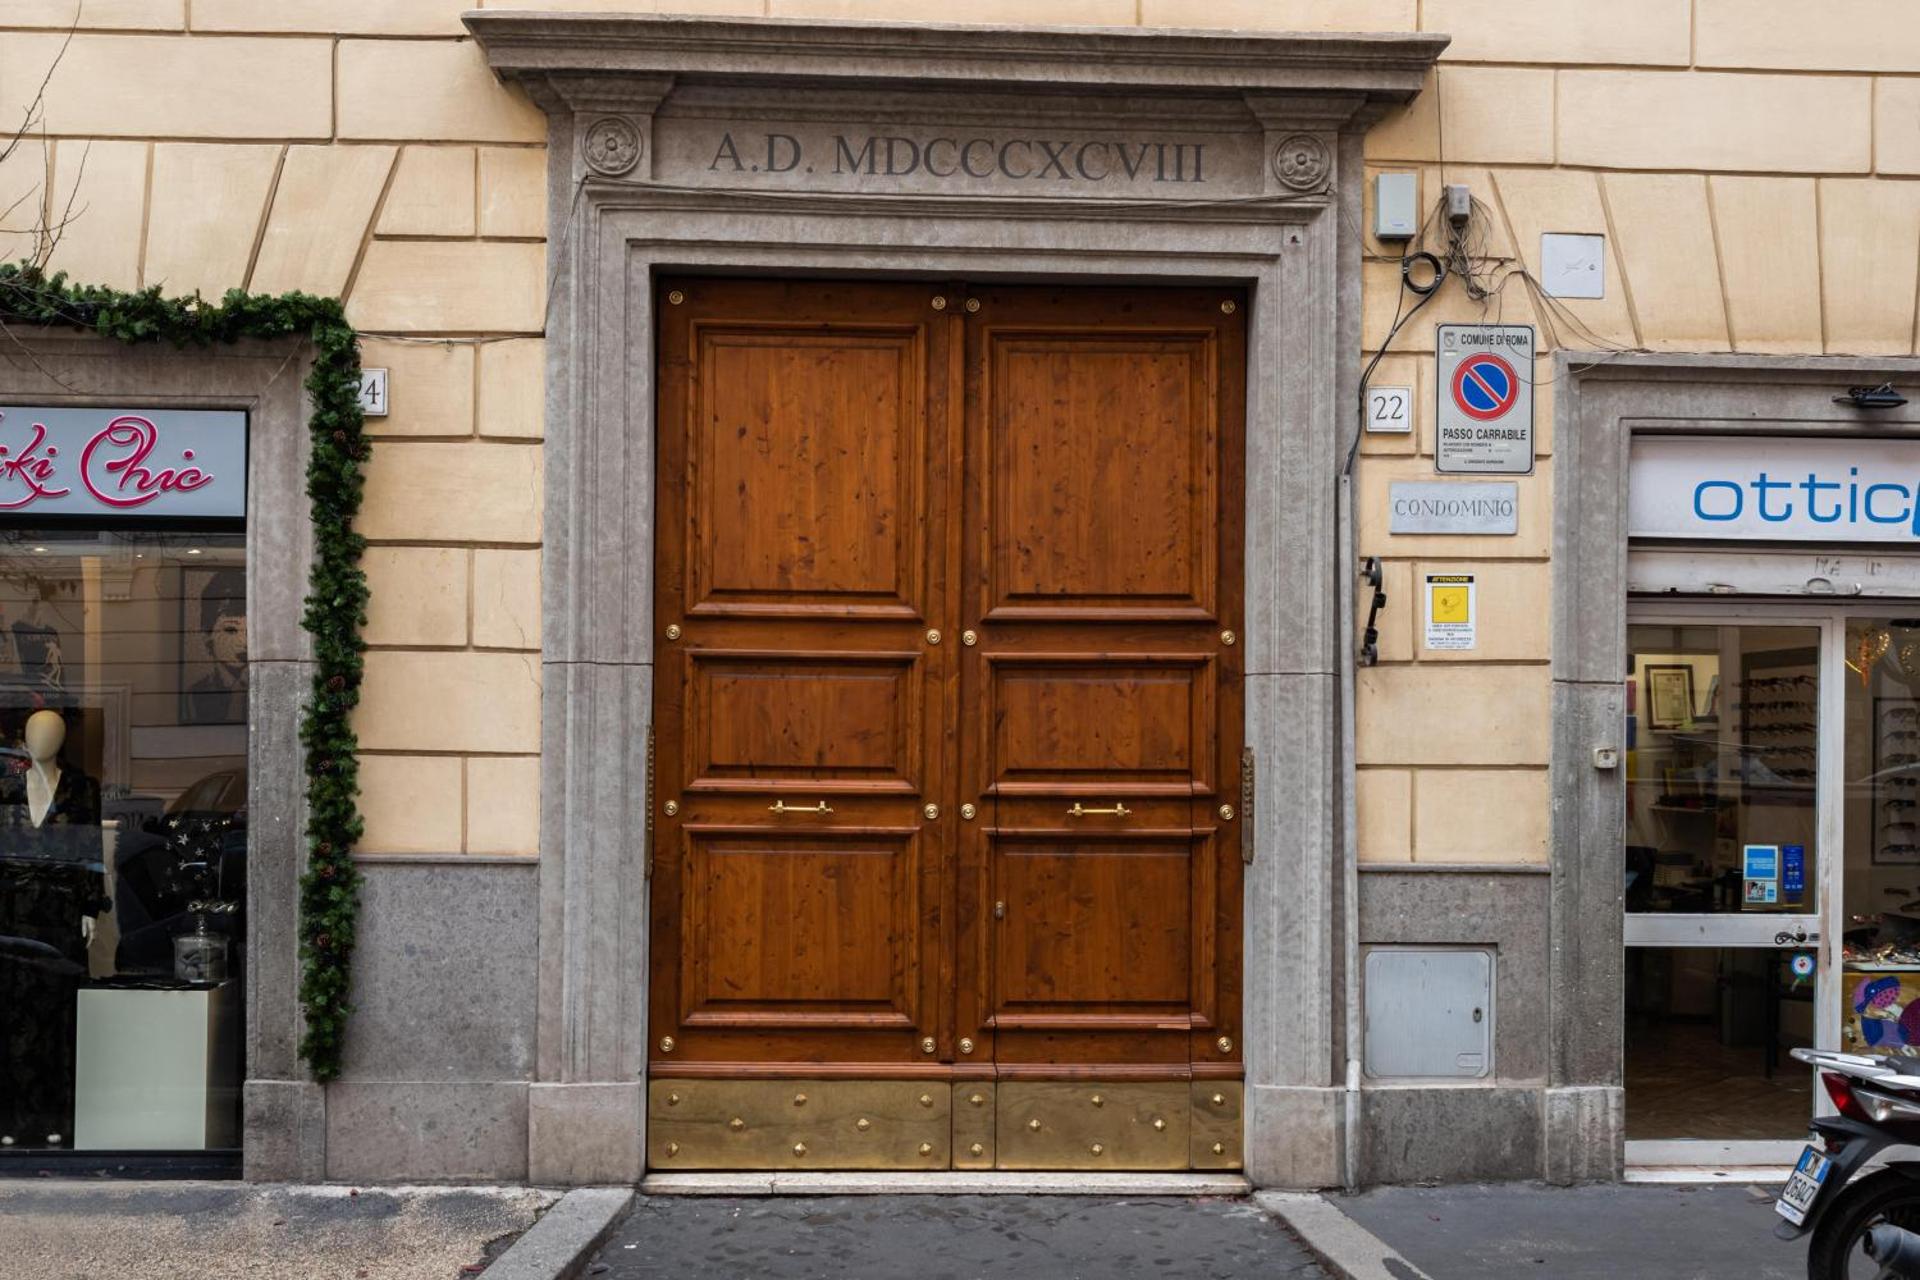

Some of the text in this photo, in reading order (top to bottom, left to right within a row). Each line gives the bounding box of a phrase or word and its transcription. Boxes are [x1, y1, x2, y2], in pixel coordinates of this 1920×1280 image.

[707, 132, 1207, 184] A.D. MDCCCXCVIII
[1461, 333, 1528, 346] COMUNE DI ROMA
[1373, 395, 1404, 421] 22
[1443, 428, 1527, 441] PASSO CARRABILE
[80, 415, 214, 509] Chic
[1394, 499, 1513, 517] CONDOMINIO
[1694, 467, 1920, 536] ottic
